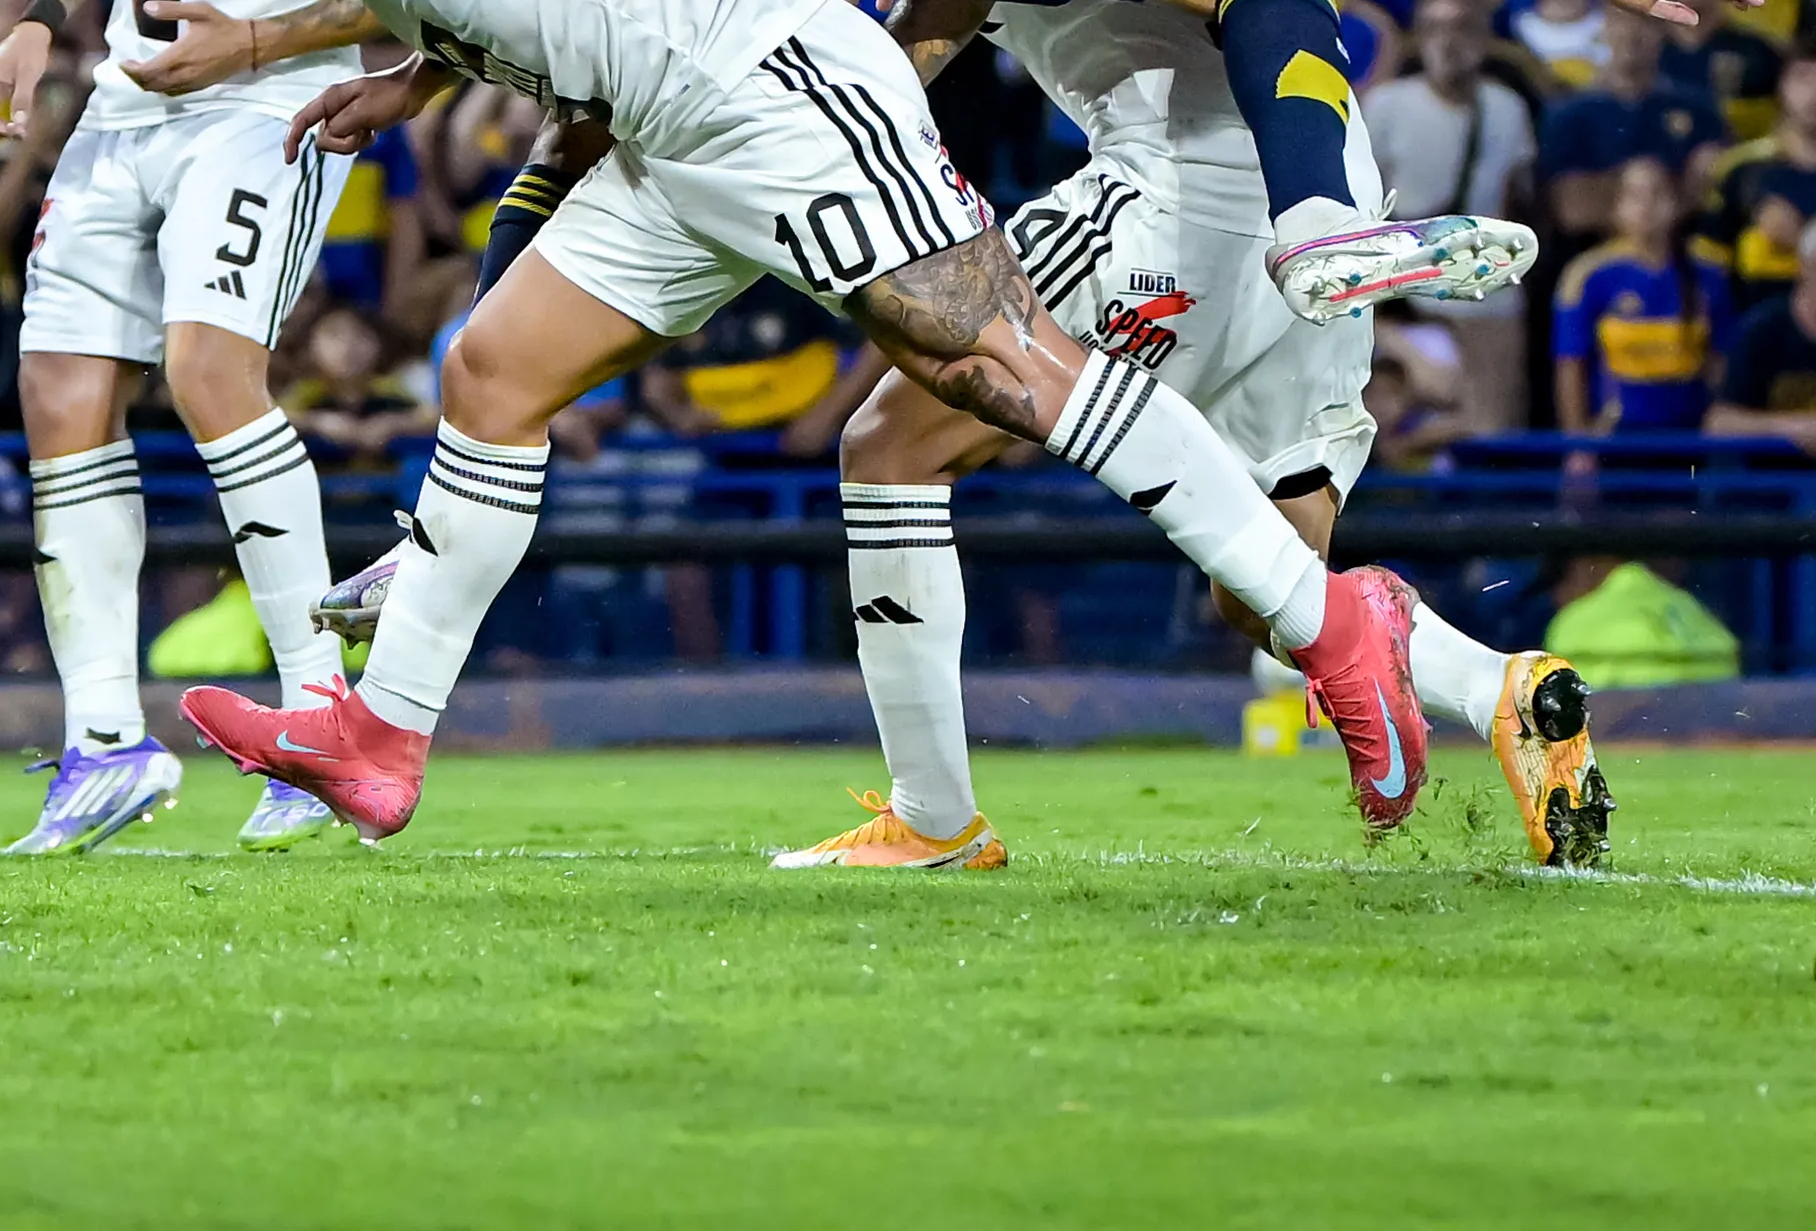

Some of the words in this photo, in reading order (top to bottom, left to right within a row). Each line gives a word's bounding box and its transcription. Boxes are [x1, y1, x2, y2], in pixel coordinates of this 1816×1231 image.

[215, 187, 268, 267] 5
[774, 192, 877, 293] 10
[1129, 272, 1176, 293] LIDER
[1095, 299, 1178, 370] SPEED
